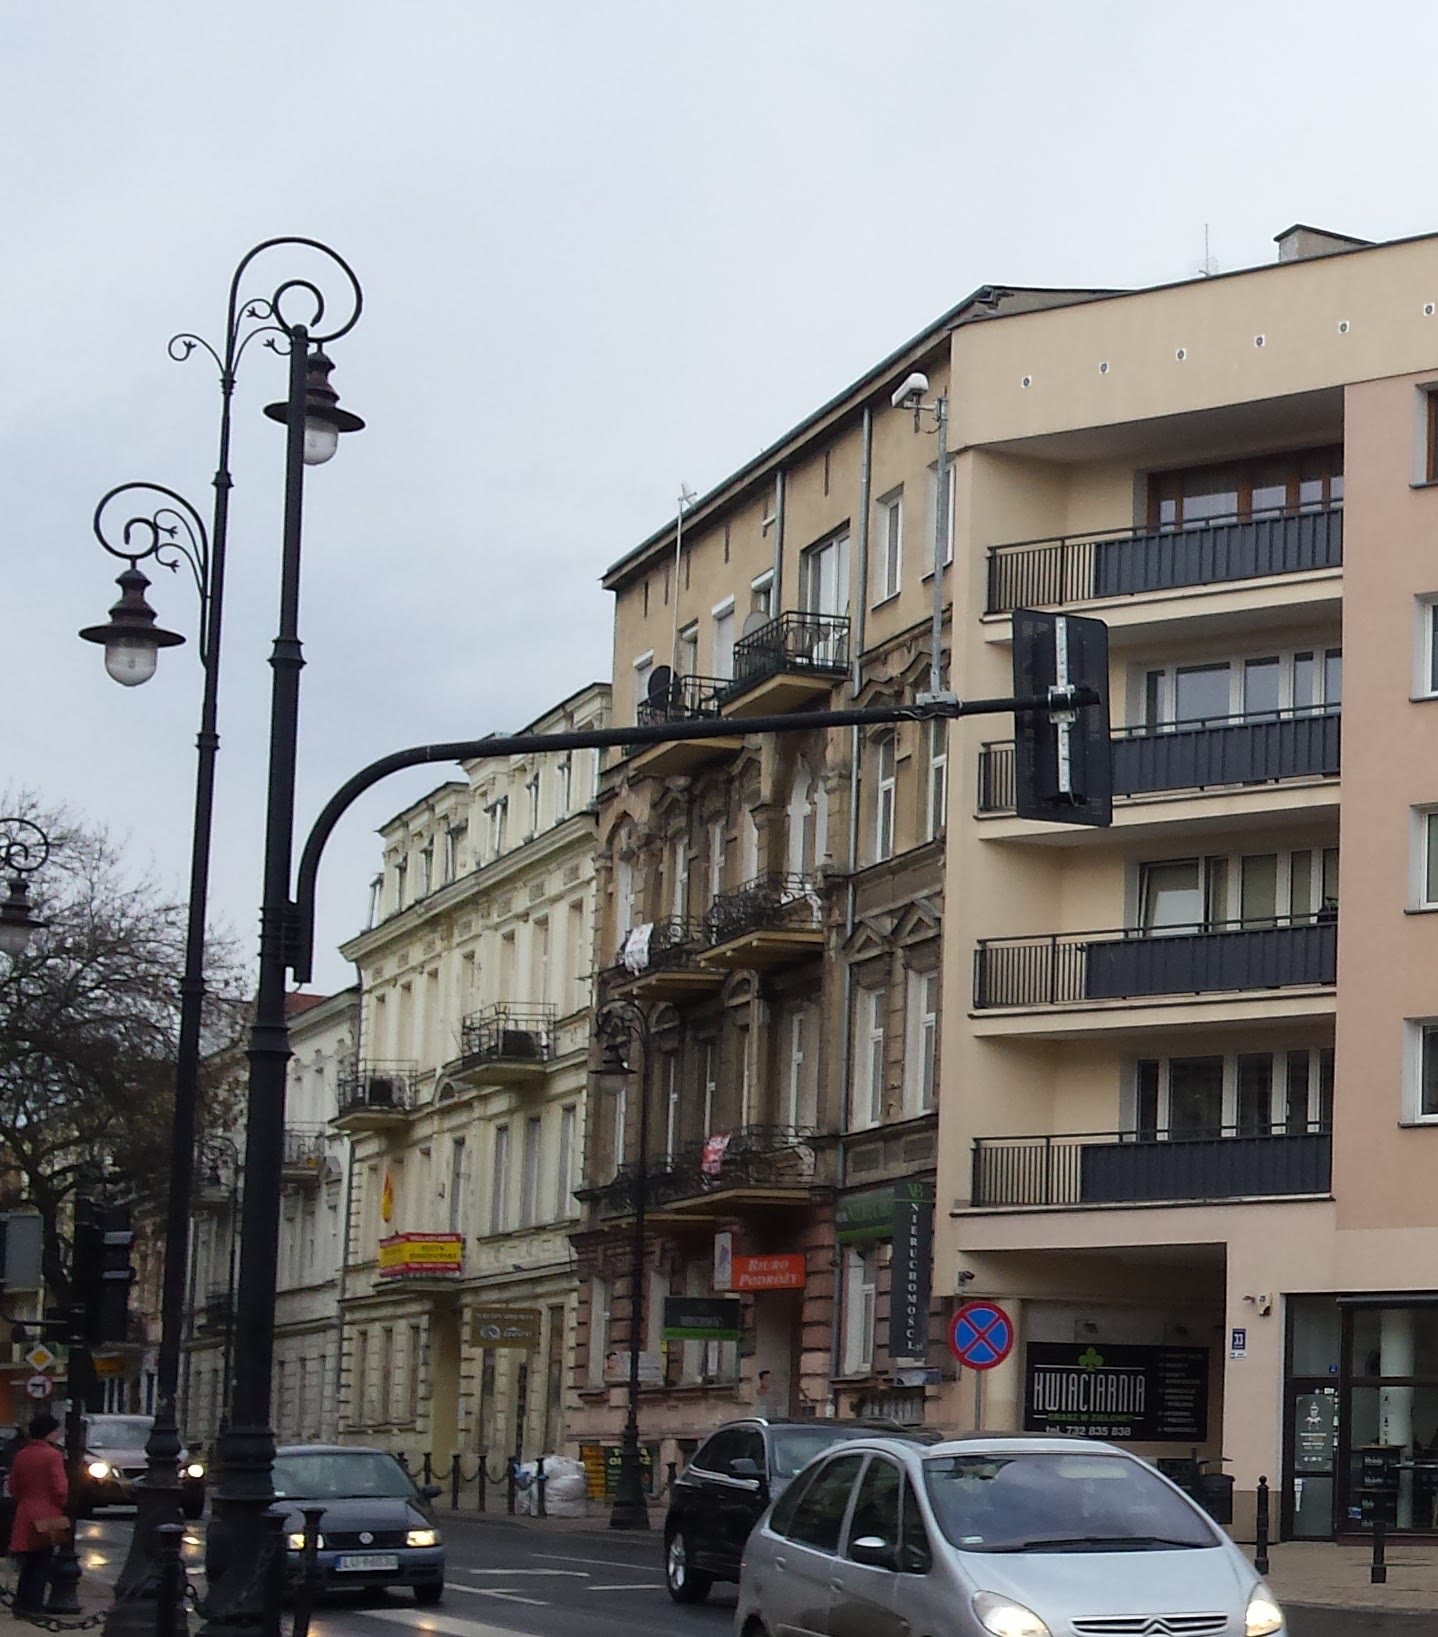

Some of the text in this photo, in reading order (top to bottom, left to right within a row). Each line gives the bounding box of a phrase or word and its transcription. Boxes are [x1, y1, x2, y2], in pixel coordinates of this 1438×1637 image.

[1233, 1333, 1244, 1345] 33
[1033, 1372, 1146, 1413] KWIACIARNIA
[1066, 1425, 1086, 1436] 732
[1088, 1426, 1109, 1436] 835
[1111, 1426, 1131, 1436] 838
